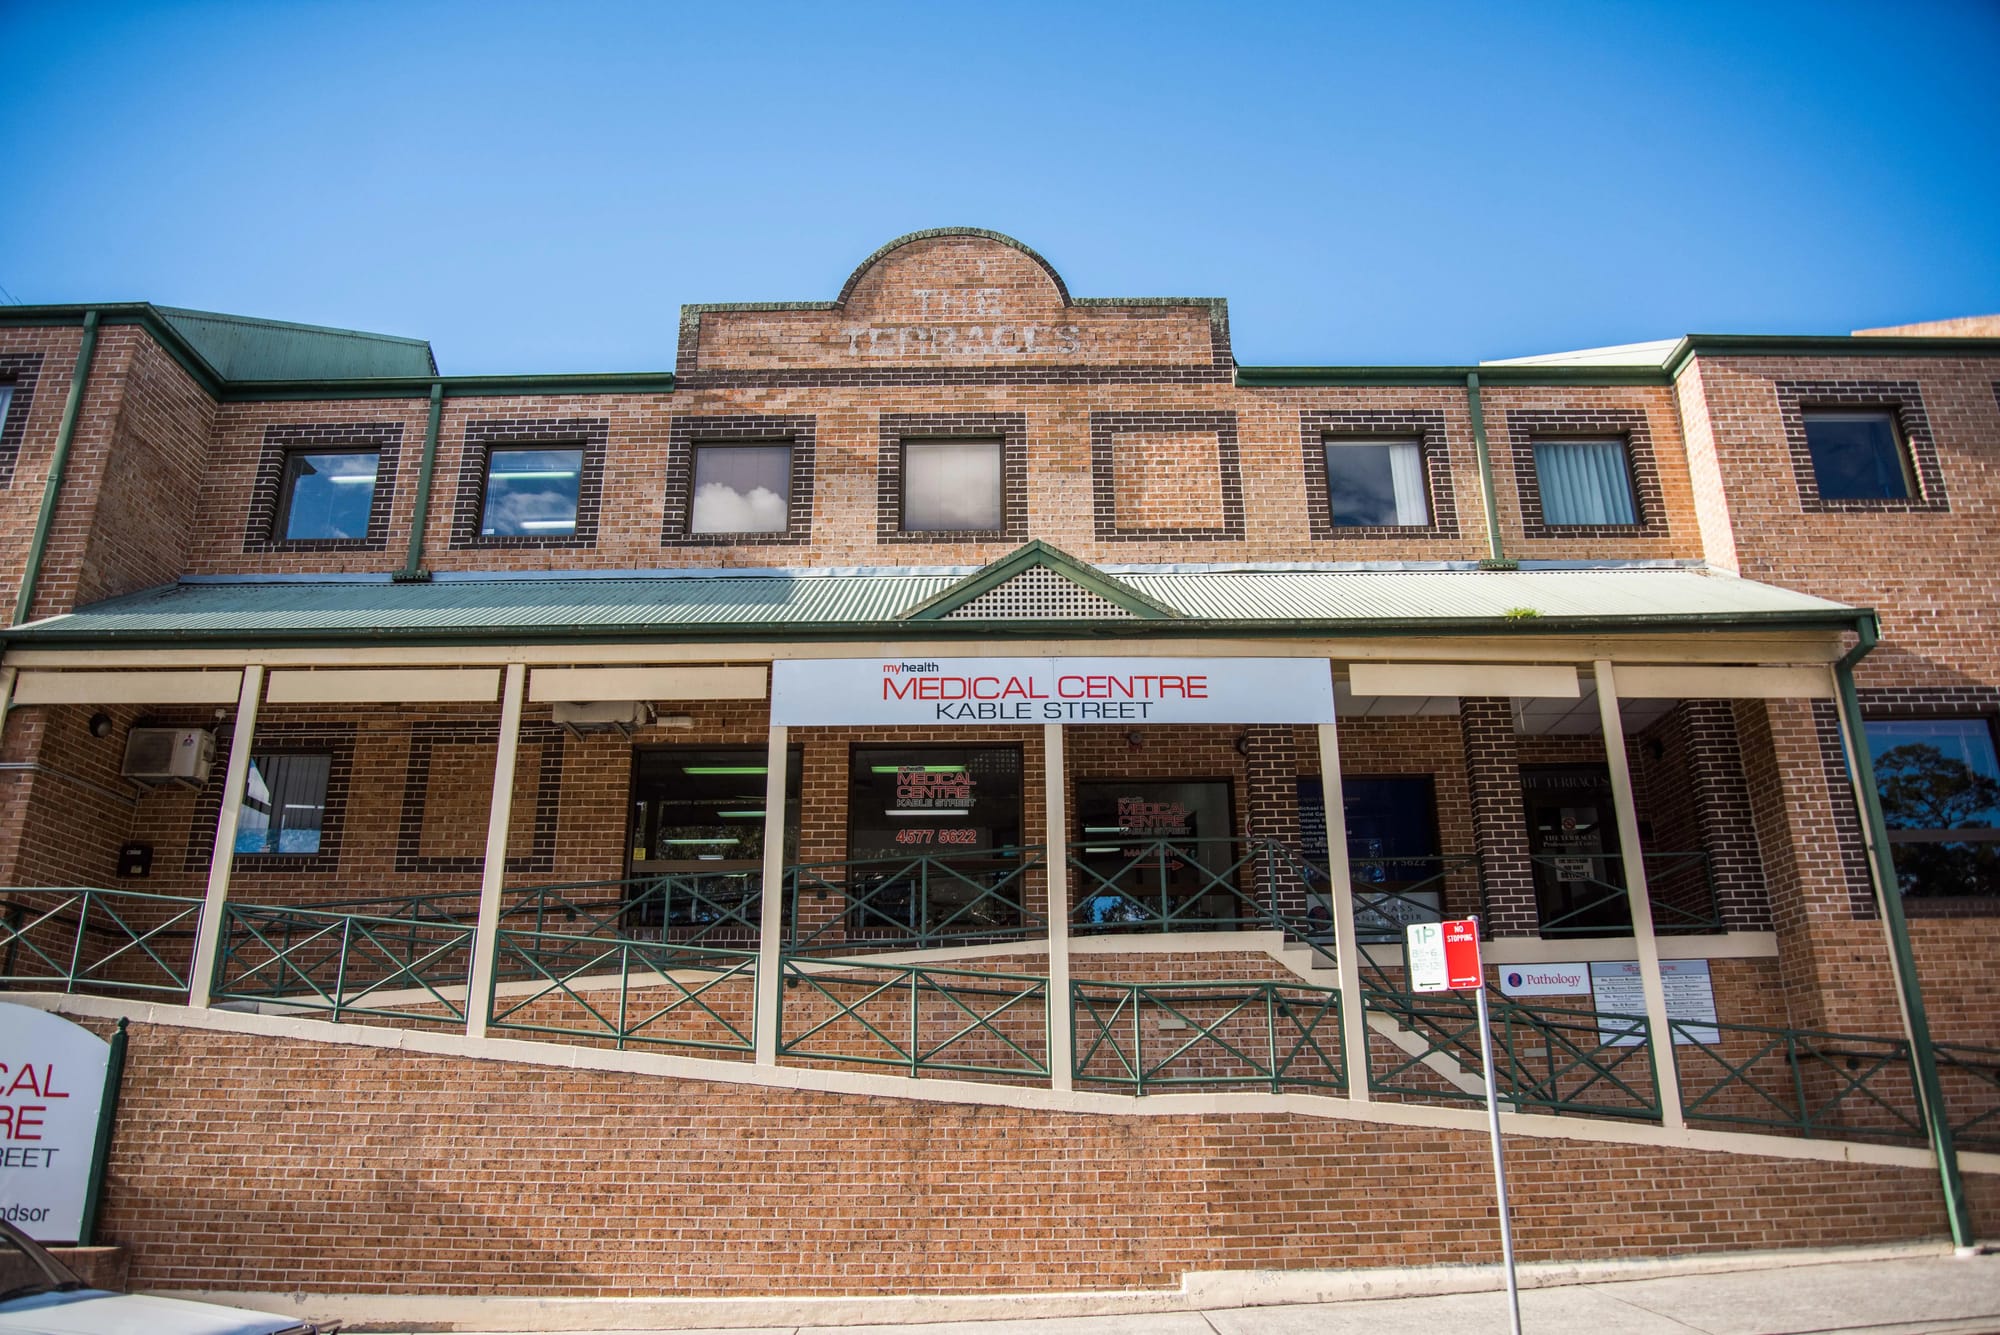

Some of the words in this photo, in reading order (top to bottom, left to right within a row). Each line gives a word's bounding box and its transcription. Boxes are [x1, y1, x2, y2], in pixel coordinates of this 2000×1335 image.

[913, 288, 1003, 315] THE
[840, 325, 1081, 356] TERRACES
[882, 661, 939, 676] myhealth
[882, 676, 1049, 700] MEDICAL
[1057, 675, 1209, 699] CENTRE
[936, 702, 1033, 720] KABLE
[1043, 701, 1154, 719] STREET
[896, 772, 977, 785] MEDICAL
[896, 785, 970, 799] CENTRE
[896, 799, 933, 807] KABLE
[934, 799, 977, 807] STREET
[1117, 802, 1191, 814] MEDICAL
[1118, 814, 1185, 828] CENTRE
[895, 829, 935, 844] 4577
[938, 829, 977, 844] 5622
[1414, 927, 1435, 944] 1P
[1453, 925, 1464, 933] NO
[1446, 933, 1474, 943] STOPPING
[1526, 973, 1581, 987] Pathology
[0, 1147, 60, 1169] EET
